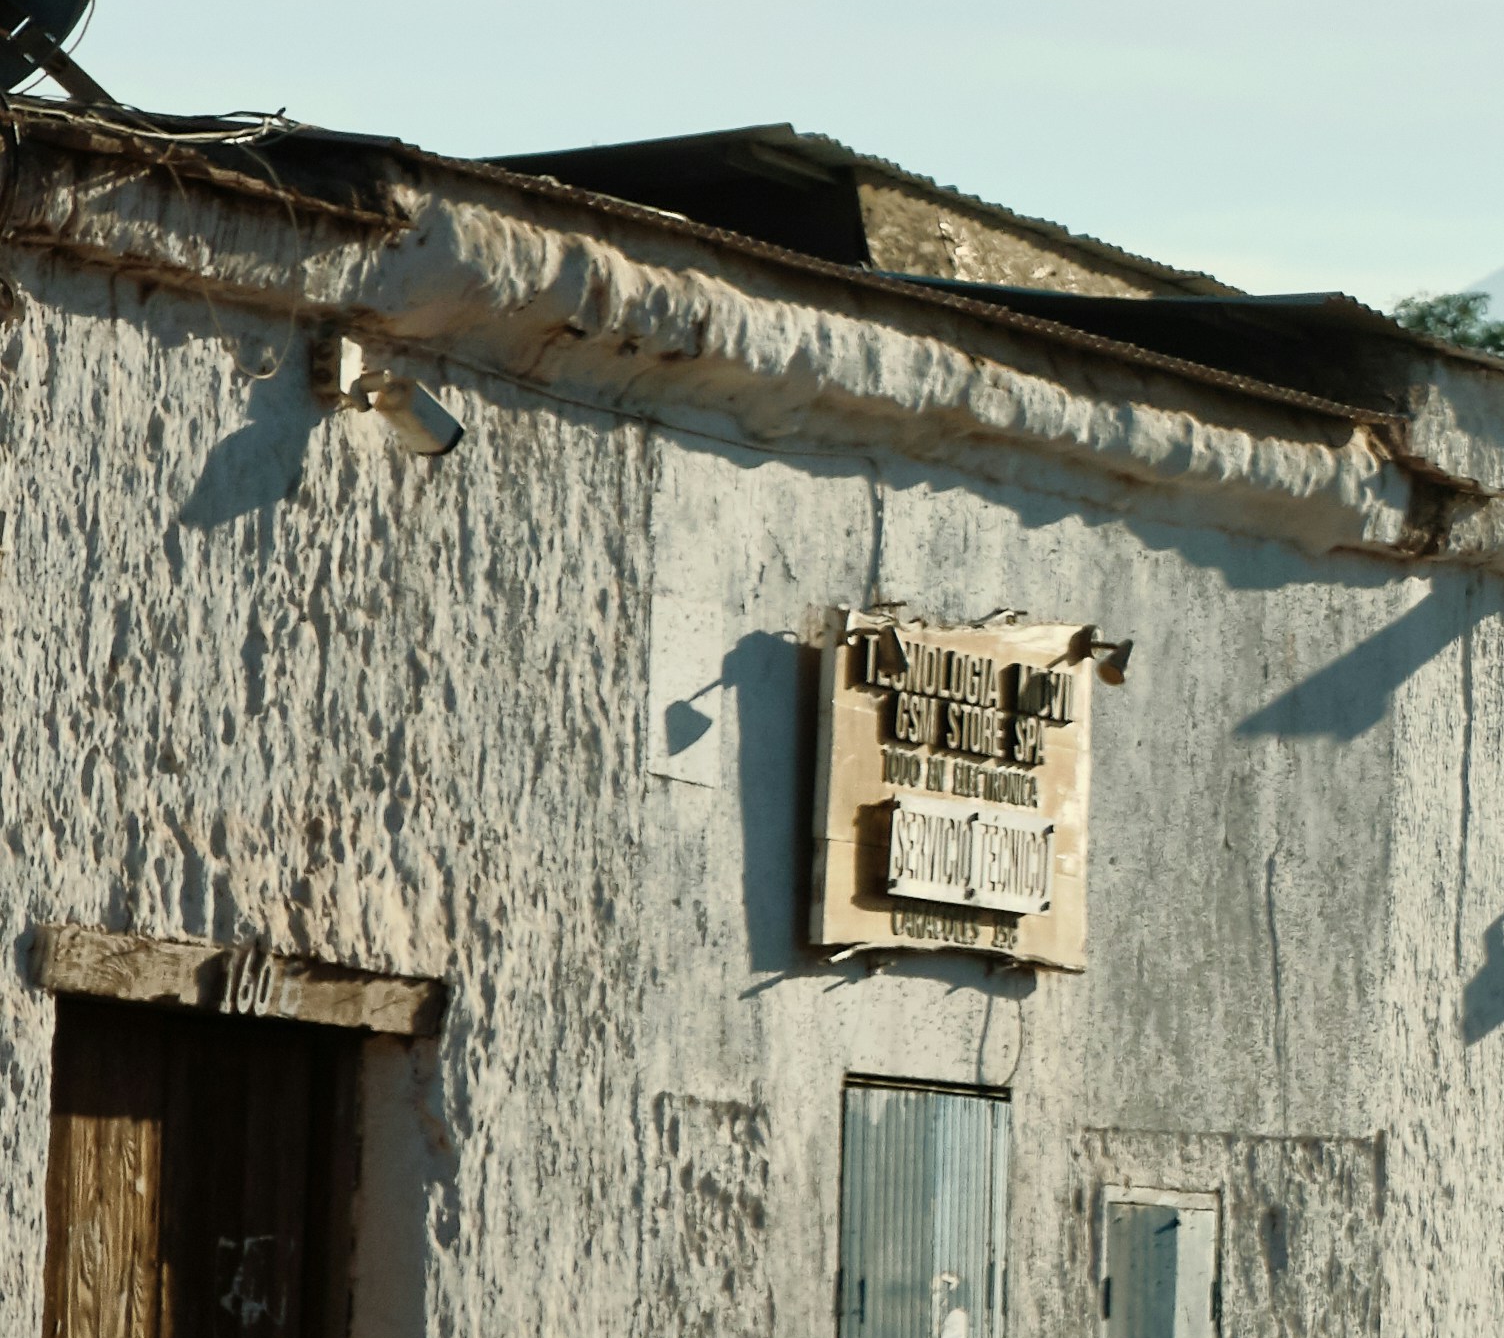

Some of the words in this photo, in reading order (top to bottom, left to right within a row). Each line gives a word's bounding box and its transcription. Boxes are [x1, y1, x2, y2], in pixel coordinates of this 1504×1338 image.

[895, 691, 938, 744] GSM
[946, 702, 1005, 757] STORE
[1014, 715, 1045, 765] SPA
[881, 749, 921, 788] TODO
[926, 756, 945, 793] EN
[894, 810, 973, 888] SERVICIO
[979, 815, 1048, 899] TÉCNICO
[219, 947, 274, 1017] 160
